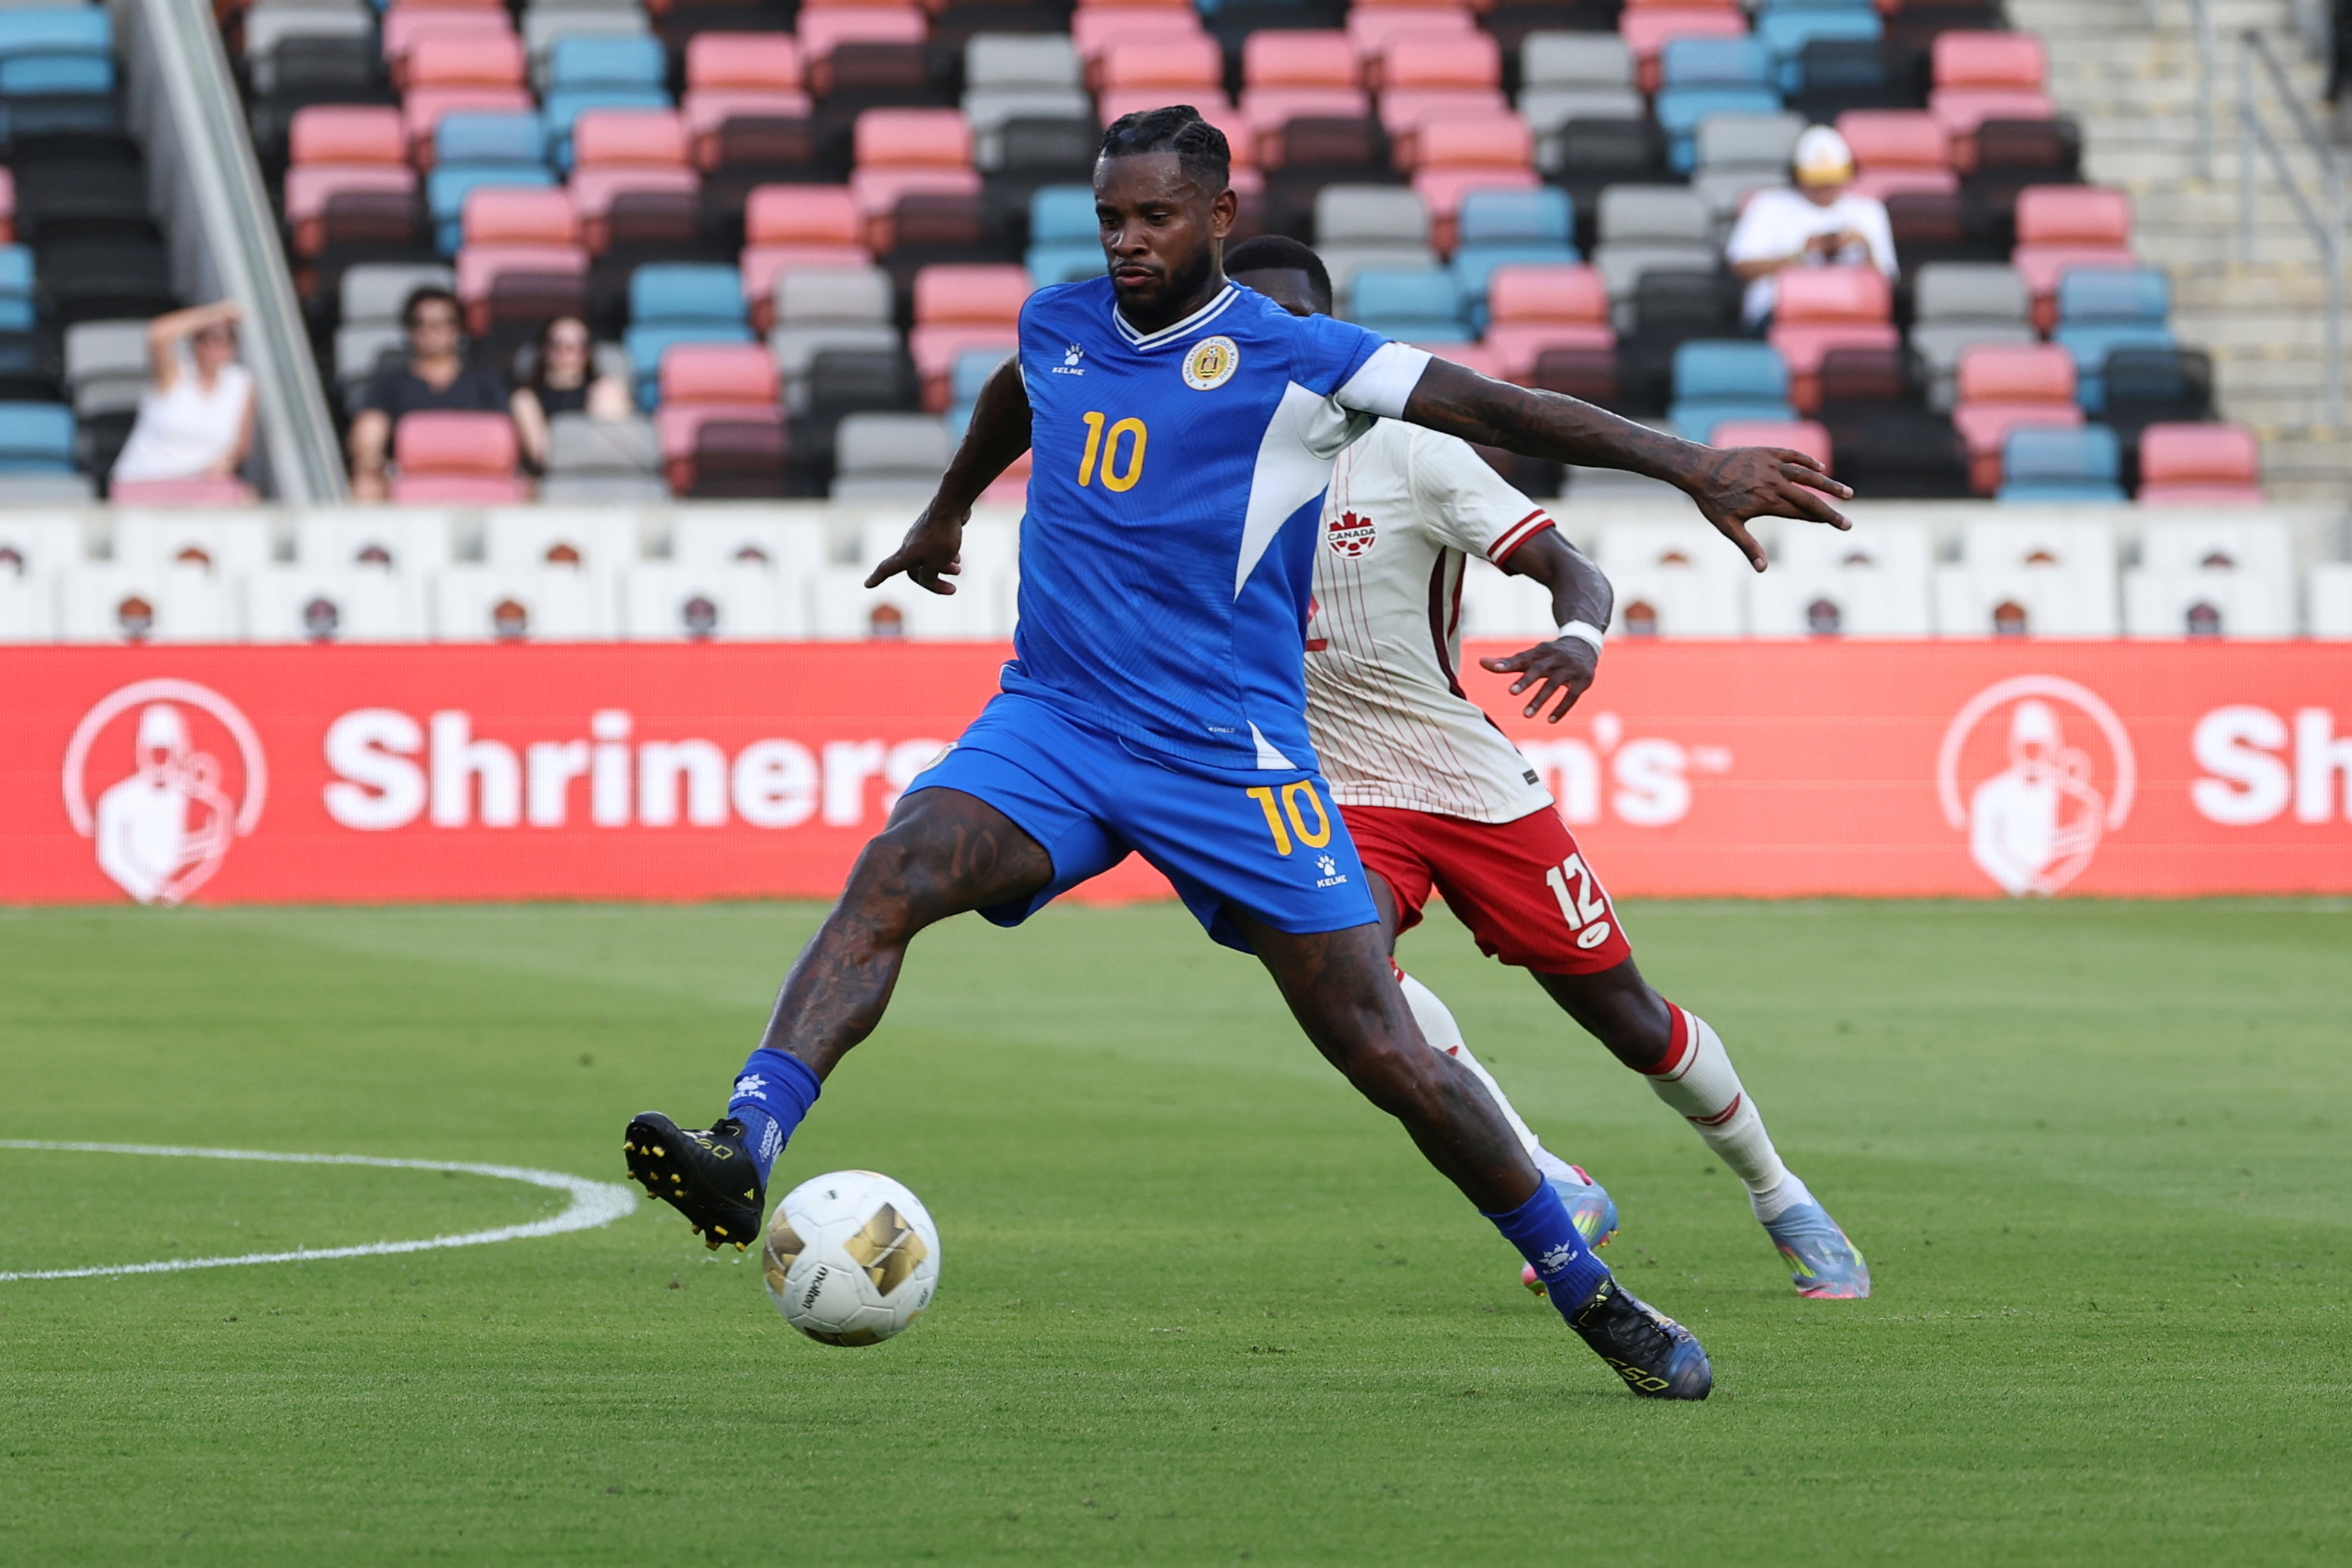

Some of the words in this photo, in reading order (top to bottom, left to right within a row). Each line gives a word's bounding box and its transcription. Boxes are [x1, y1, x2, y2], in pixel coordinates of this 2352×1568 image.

[1051, 366, 1085, 376] KELME
[1078, 411, 1148, 492] 10
[1327, 528, 1376, 542] CANADA
[2191, 704, 2352, 826] Sh
[1245, 779, 1332, 856] 10
[1317, 874, 1348, 889] KELME
[1546, 851, 1606, 932] 12
[801, 1266, 829, 1310] molten
